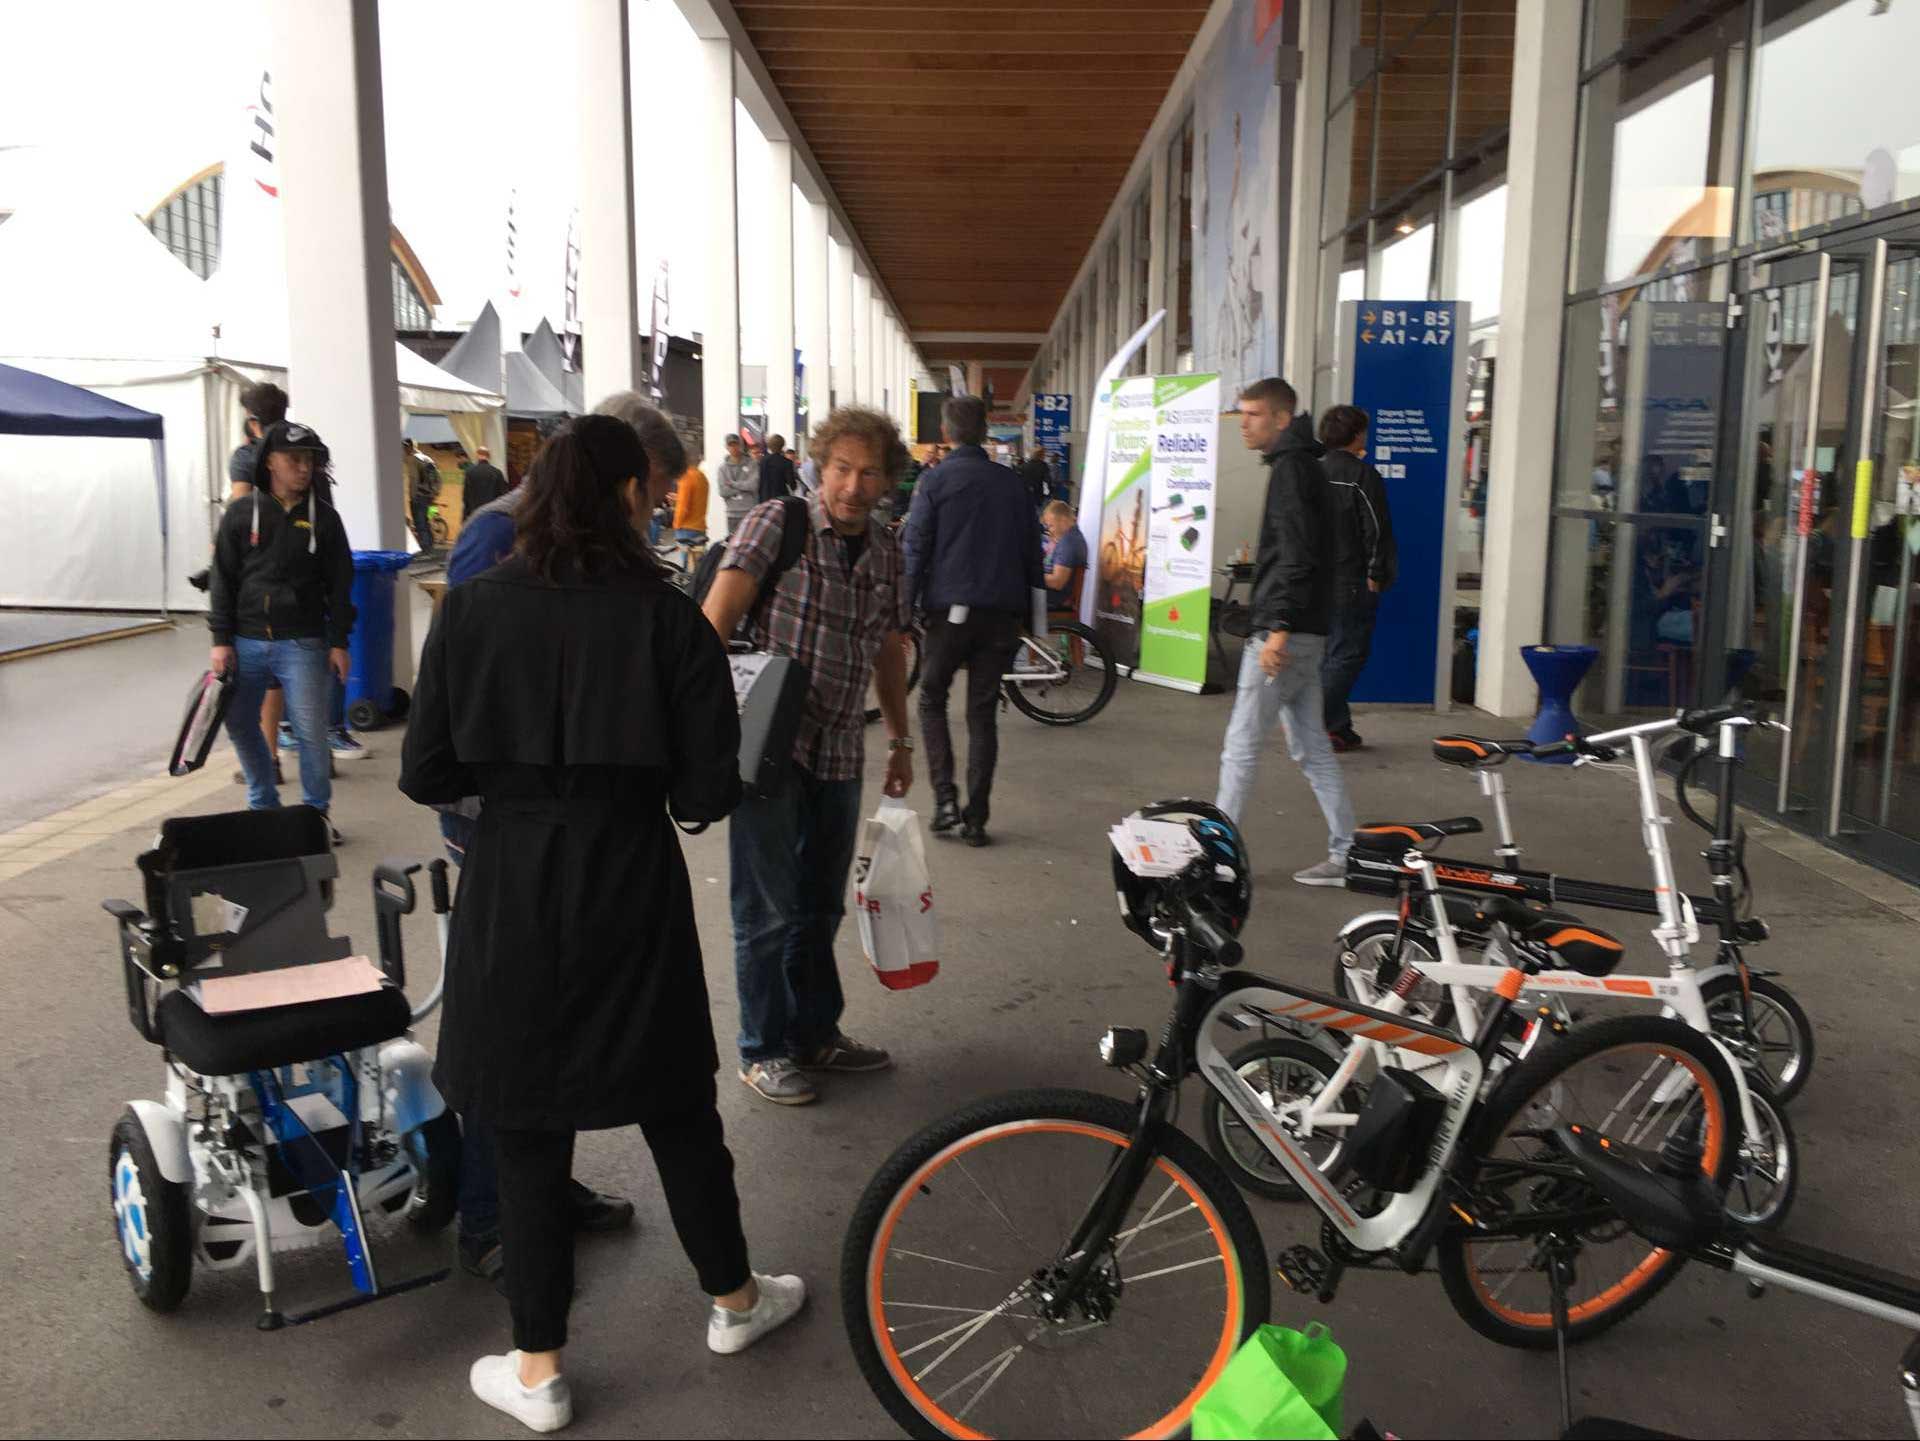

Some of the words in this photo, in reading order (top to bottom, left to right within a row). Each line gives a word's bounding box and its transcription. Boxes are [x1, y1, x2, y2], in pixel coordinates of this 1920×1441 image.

[1382, 310, 1407, 326] B1
[1424, 310, 1450, 326] B5
[1380, 329, 1406, 345] A1
[1422, 329, 1450, 345] A7
[1043, 395, 1069, 411] B2
[1157, 433, 1208, 452] Reliable
